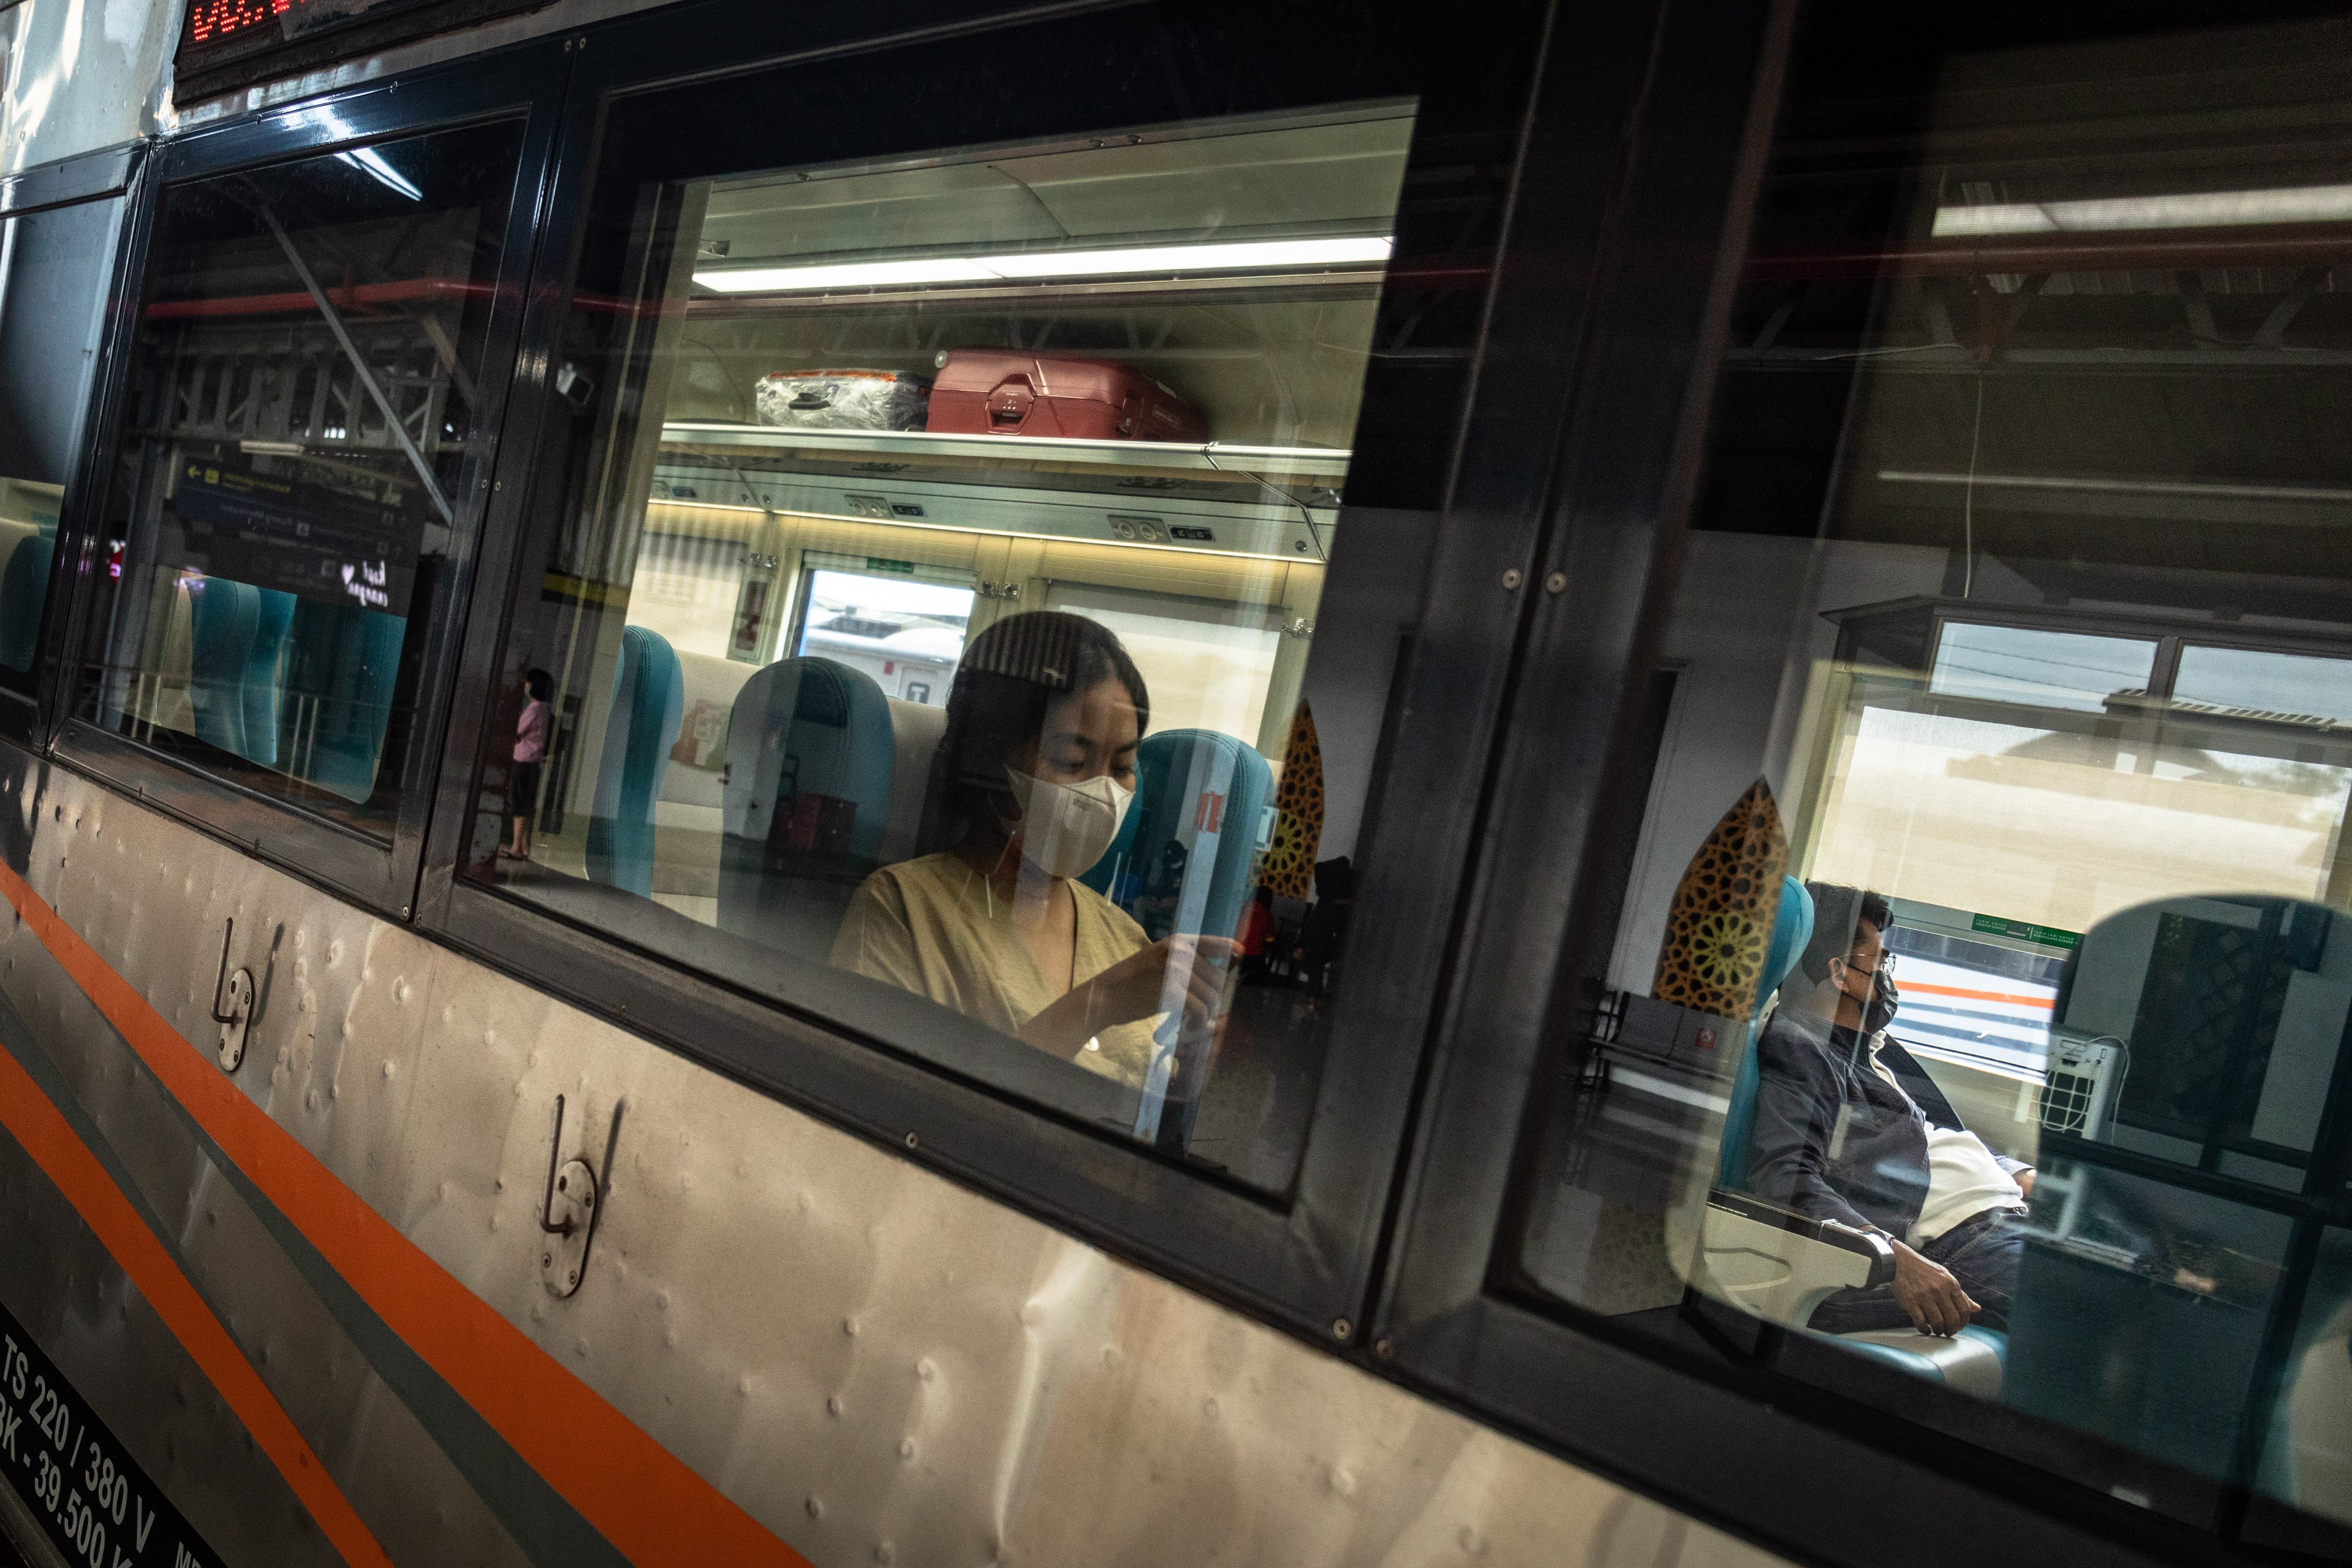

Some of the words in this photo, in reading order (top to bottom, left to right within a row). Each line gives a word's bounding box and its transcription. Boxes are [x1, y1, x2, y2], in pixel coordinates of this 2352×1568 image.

[3, 1333, 29, 1400] TS
[29, 1375, 69, 1451] 220
[85, 1442, 128, 1525] 380
[136, 1493, 156, 1554] V
[35, 1450, 106, 1568] 39.500
